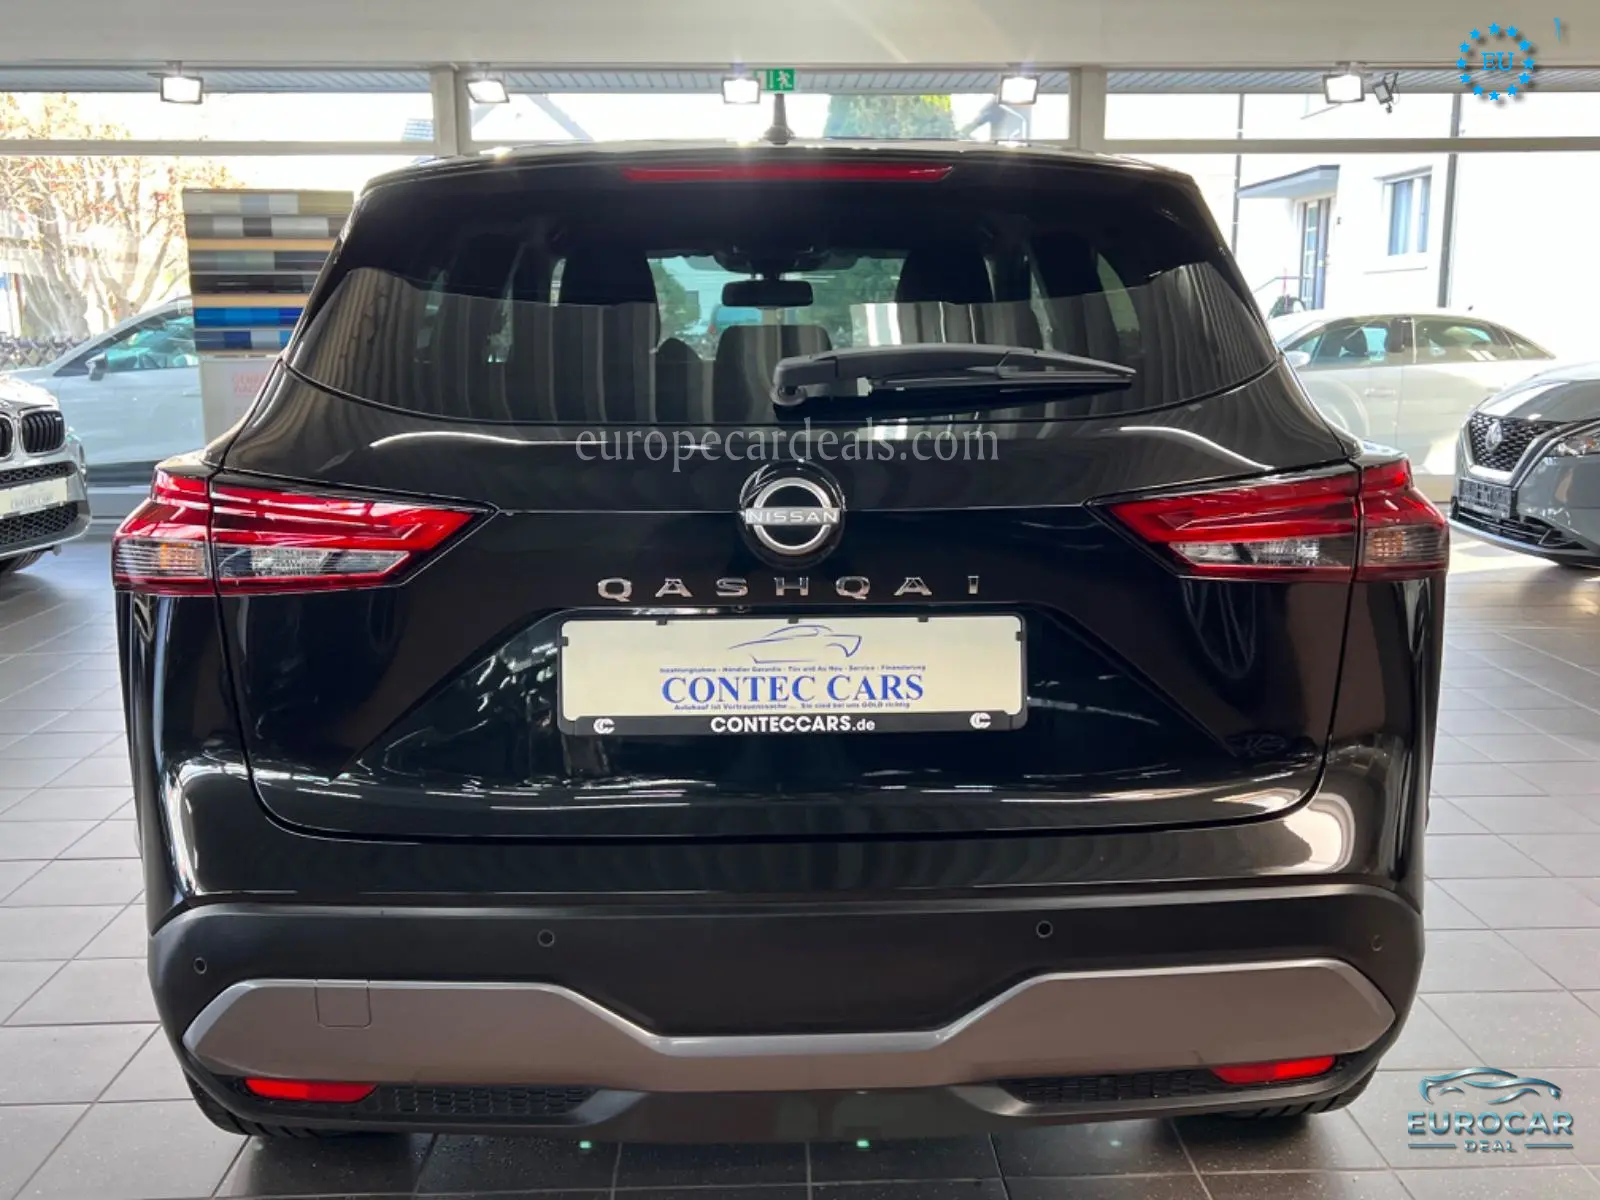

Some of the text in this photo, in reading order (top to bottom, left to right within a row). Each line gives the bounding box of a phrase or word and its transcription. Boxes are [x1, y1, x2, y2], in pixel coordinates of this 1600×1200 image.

[745, 509, 839, 524] NISSAN
[597, 576, 981, 602] QASHQAI
[661, 673, 924, 704] CONTEC CARS
[710, 715, 876, 733] CONTECCARS.de
